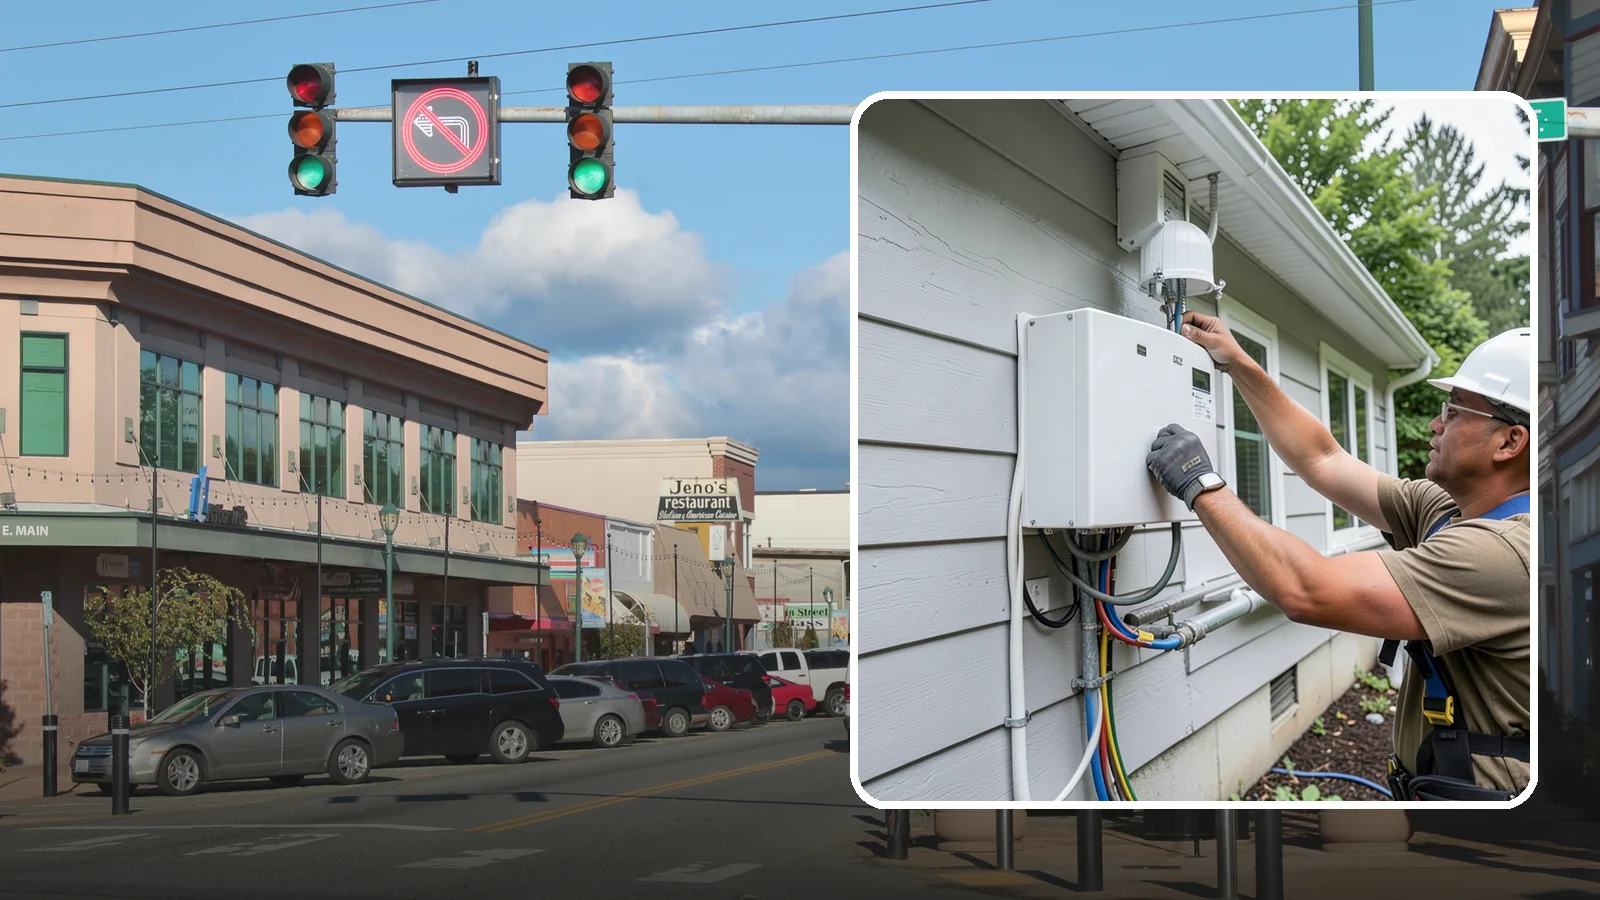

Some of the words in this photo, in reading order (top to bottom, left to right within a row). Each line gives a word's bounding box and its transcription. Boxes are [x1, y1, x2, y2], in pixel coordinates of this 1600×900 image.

[670, 480, 727, 494] Jeno's
[665, 496, 731, 509] restaurant
[658, 509, 682, 520] Italian
[686, 509, 714, 519] American
[715, 509, 737, 519] Cuisine
[2, 525, 13, 536] E.
[15, 525, 49, 536] MAIN
[797, 608, 828, 616] Street
